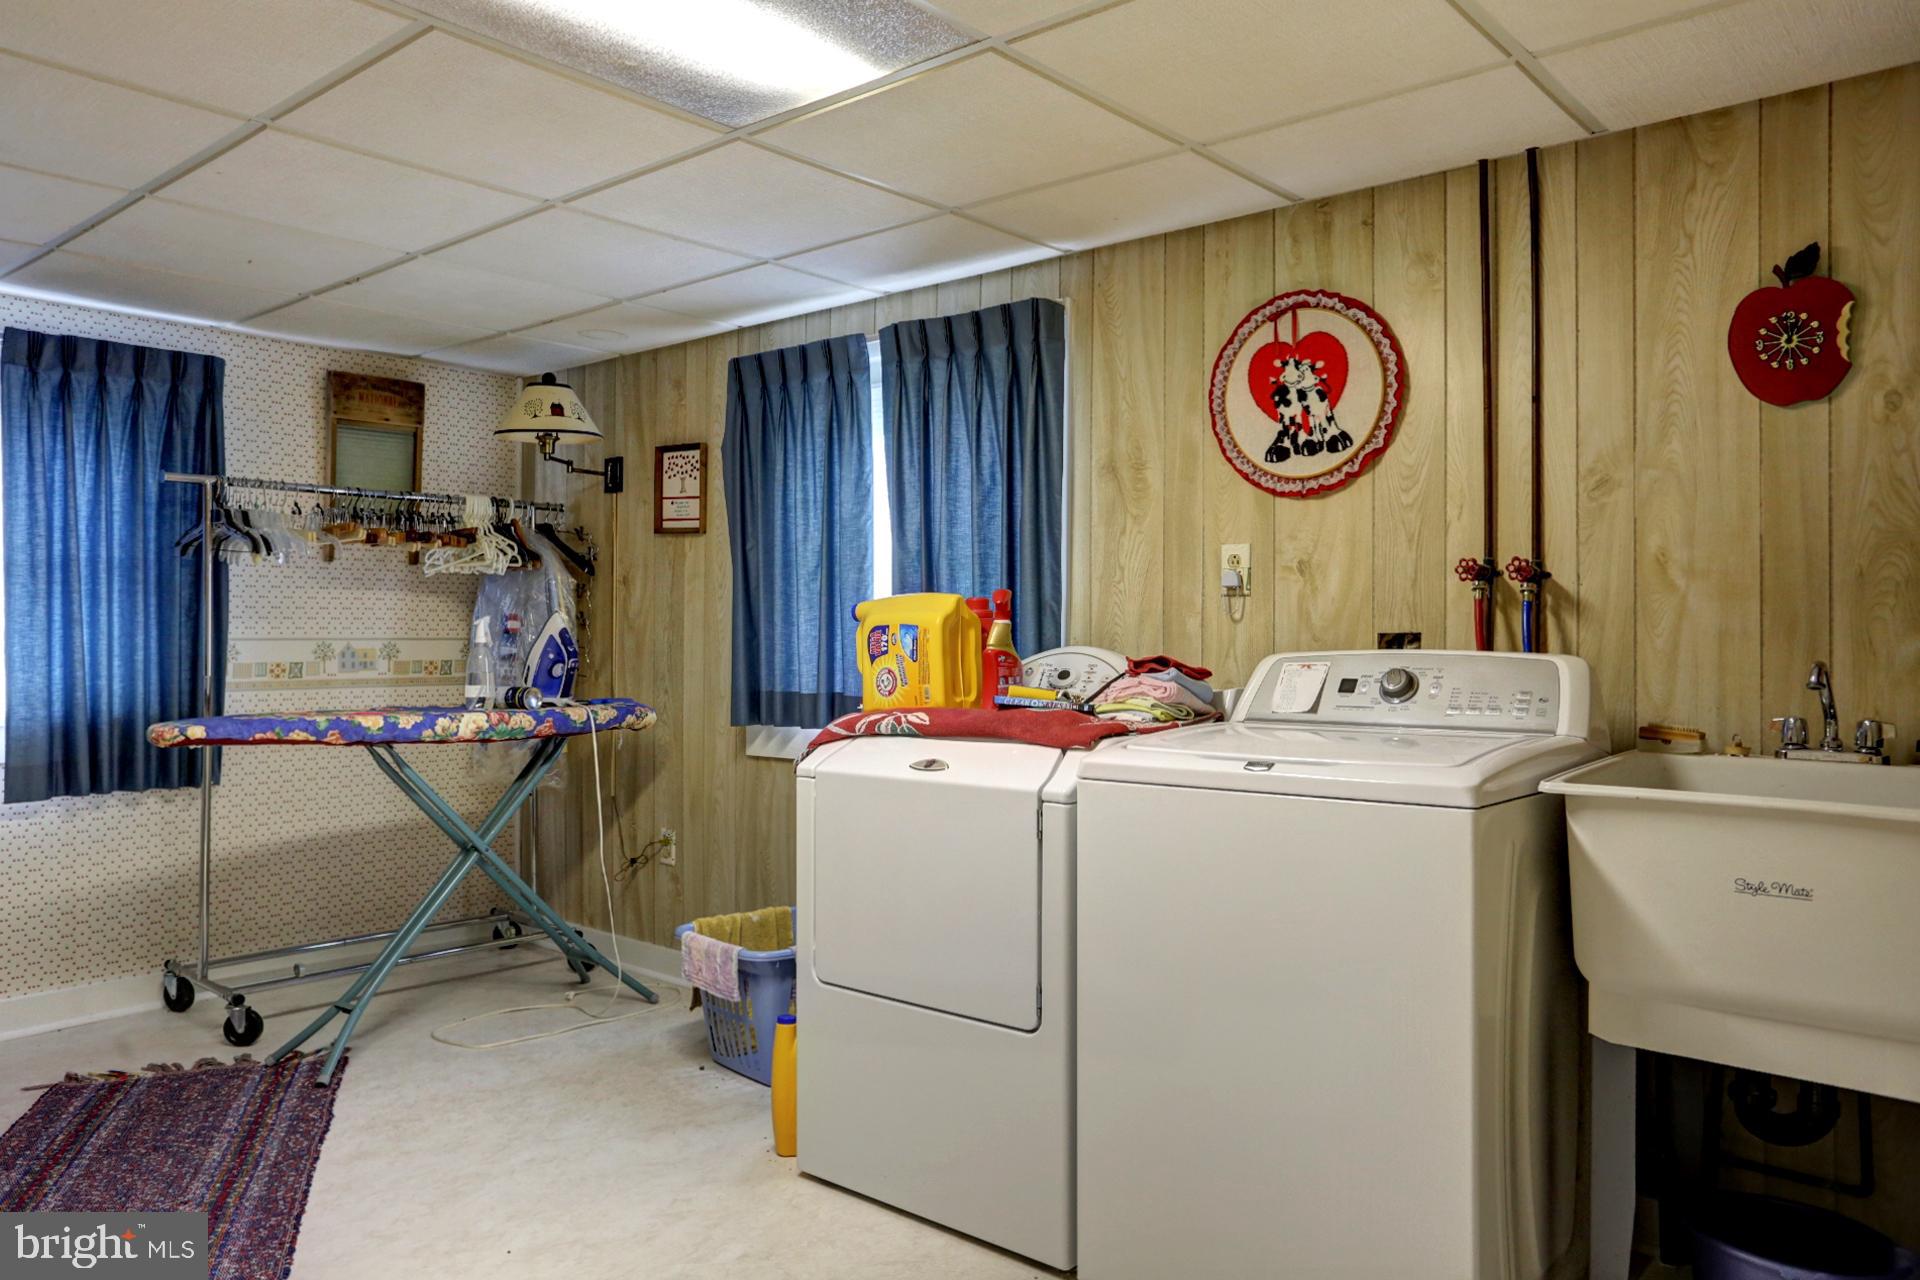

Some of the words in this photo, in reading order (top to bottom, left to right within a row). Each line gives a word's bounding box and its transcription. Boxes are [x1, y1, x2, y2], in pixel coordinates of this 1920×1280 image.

[1816, 331, 1824, 344] 3
[1755, 339, 1764, 351] 9
[1785, 358, 1794, 370] 6
[1734, 877, 1770, 897] Style
